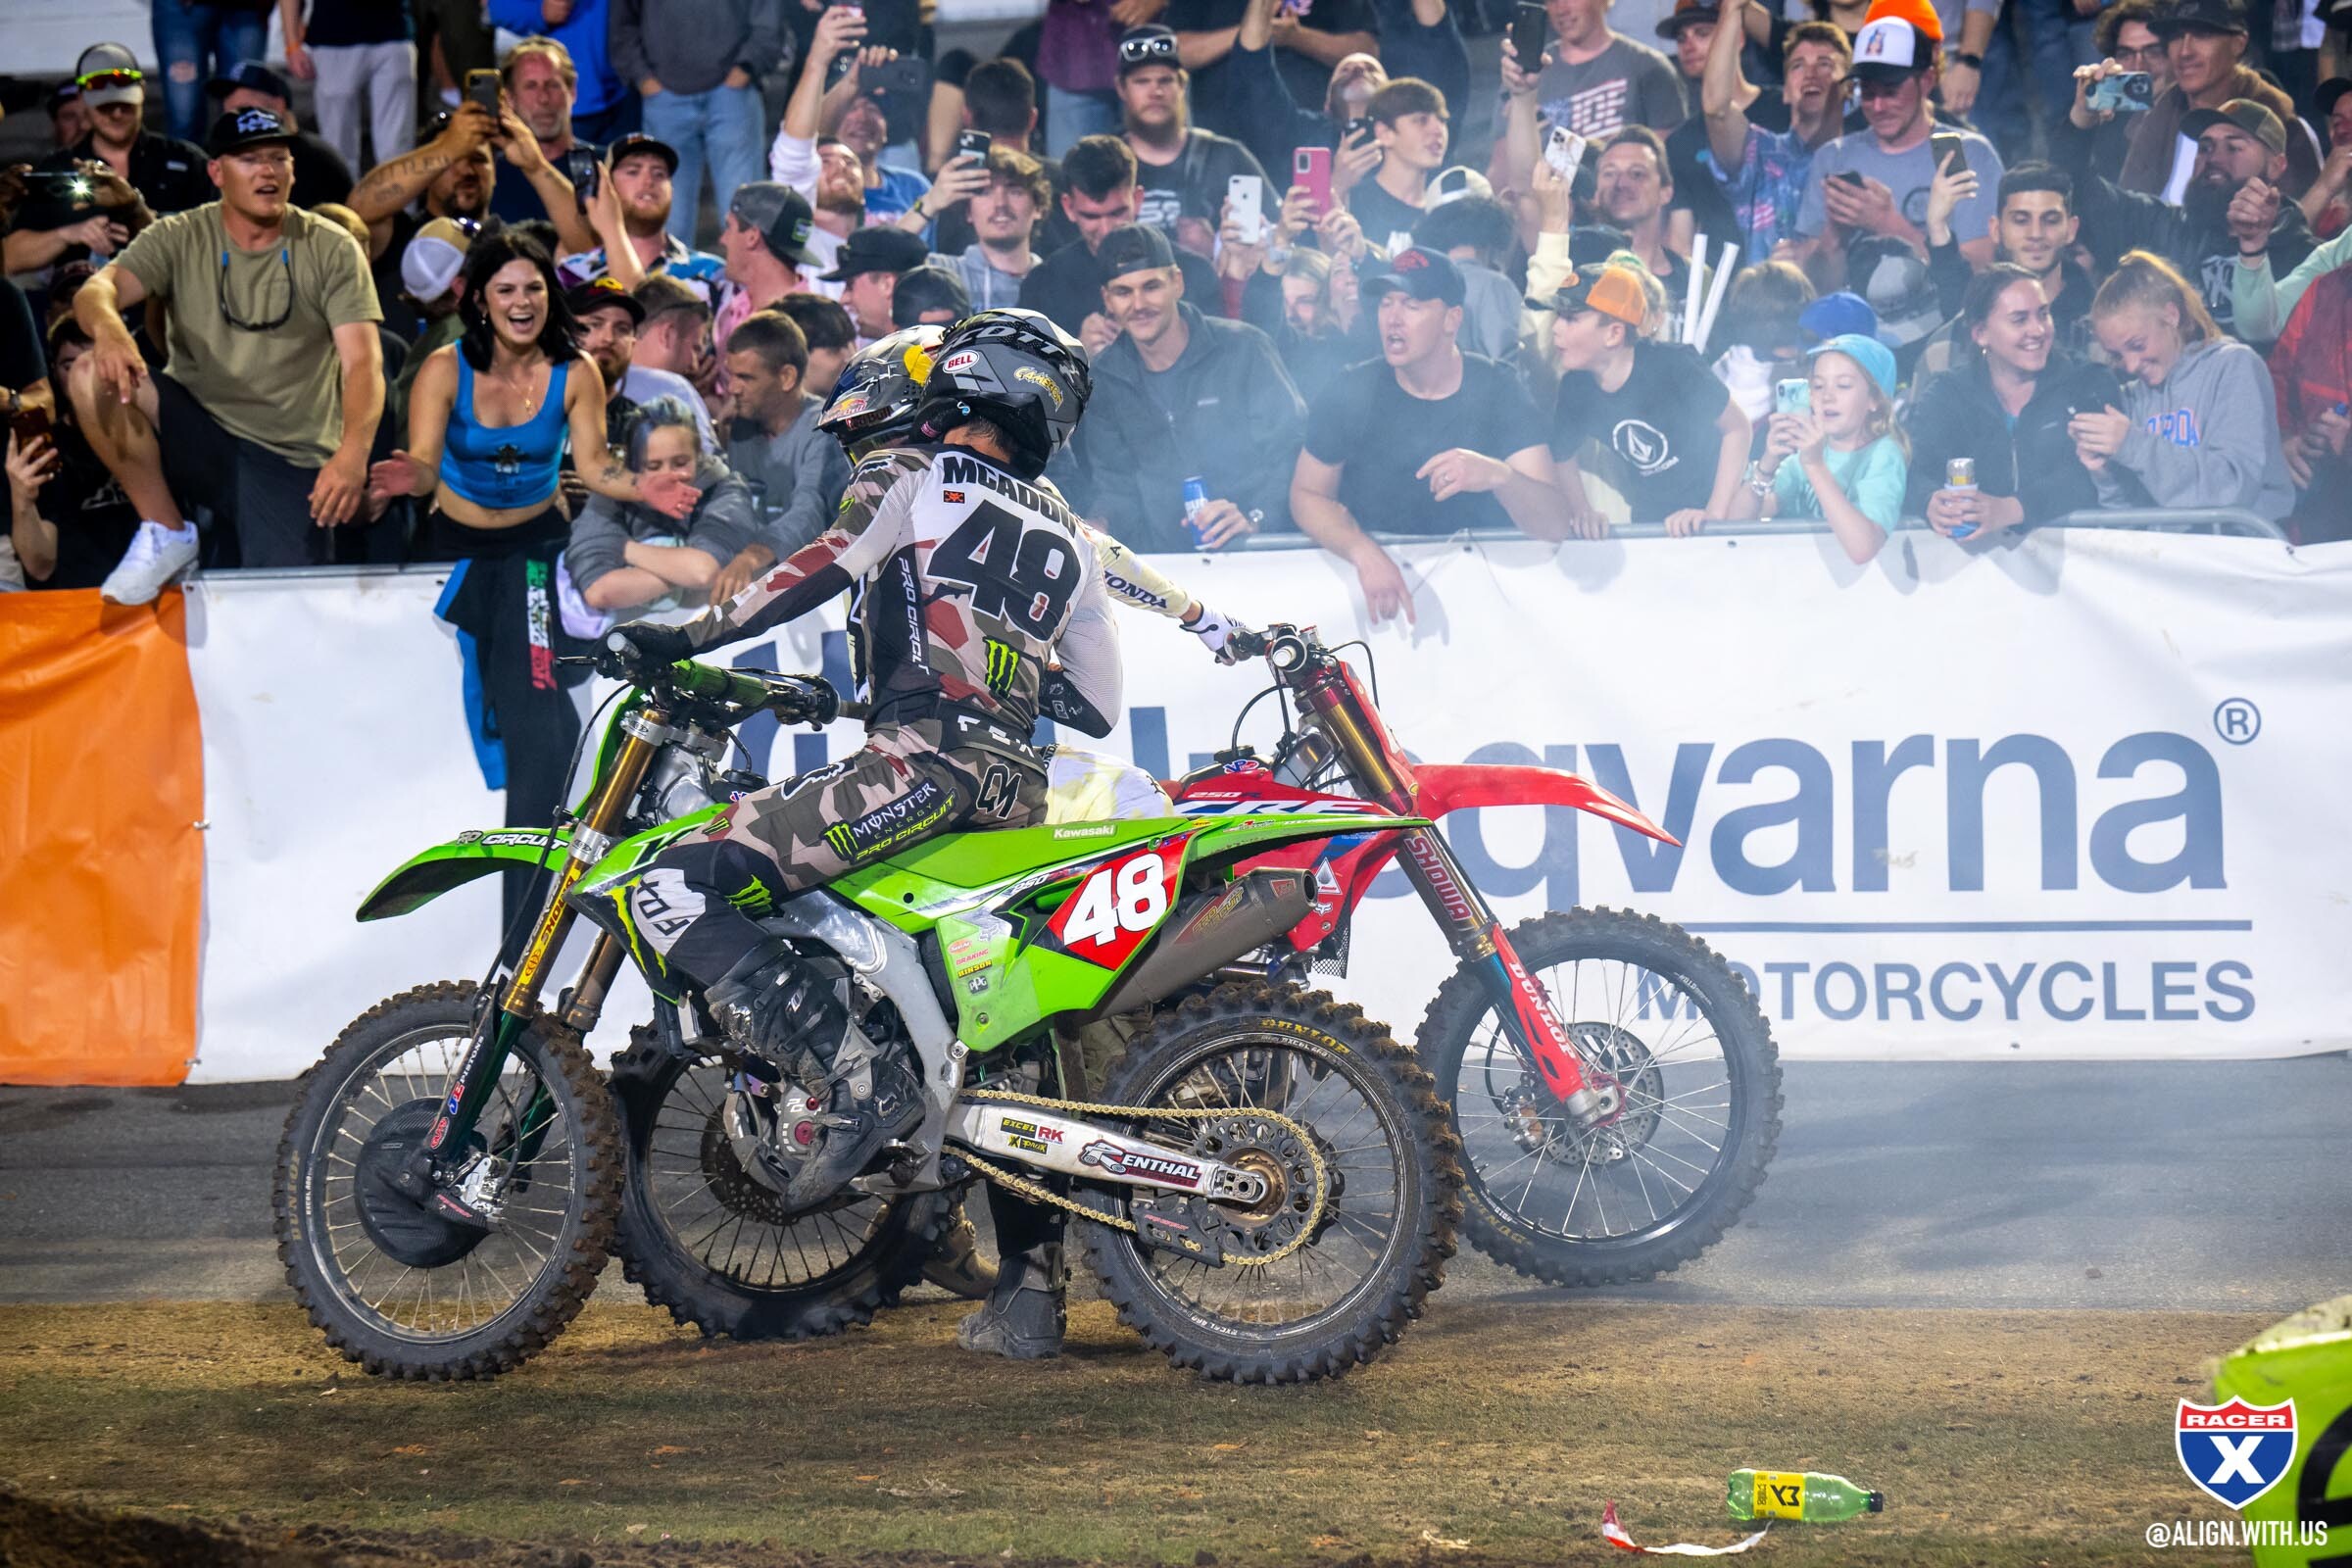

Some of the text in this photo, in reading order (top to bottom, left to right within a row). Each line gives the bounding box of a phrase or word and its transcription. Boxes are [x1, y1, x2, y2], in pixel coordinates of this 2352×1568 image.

[947, 354, 973, 369] BELL
[1013, 366, 1063, 412] CAMERON
[925, 498, 1082, 643] 48
[899, 557, 930, 676] PRO CIRCT
[853, 782, 937, 838] MONSTER
[857, 792, 956, 860] PRO CIRCUIT
[874, 803, 932, 840] ENERGY
[1173, 800, 1374, 815] CRF
[1054, 824, 1115, 840] Kawasaki
[1011, 873, 1049, 894] 250
[1403, 835, 1474, 922] SHOWA
[636, 879, 691, 937] FOX
[1062, 853, 1169, 947] 48
[956, 948, 989, 966] BRAKING
[957, 959, 993, 978] HINSON
[969, 976, 987, 991] PPG
[1509, 961, 1577, 1059] DUNLOP
[1260, 1018, 1350, 1055] DUNLOP
[460, 1035, 485, 1084] PISTONS
[1003, 1118, 1036, 1133] EXCEL
[1038, 1126, 1065, 1143] RK
